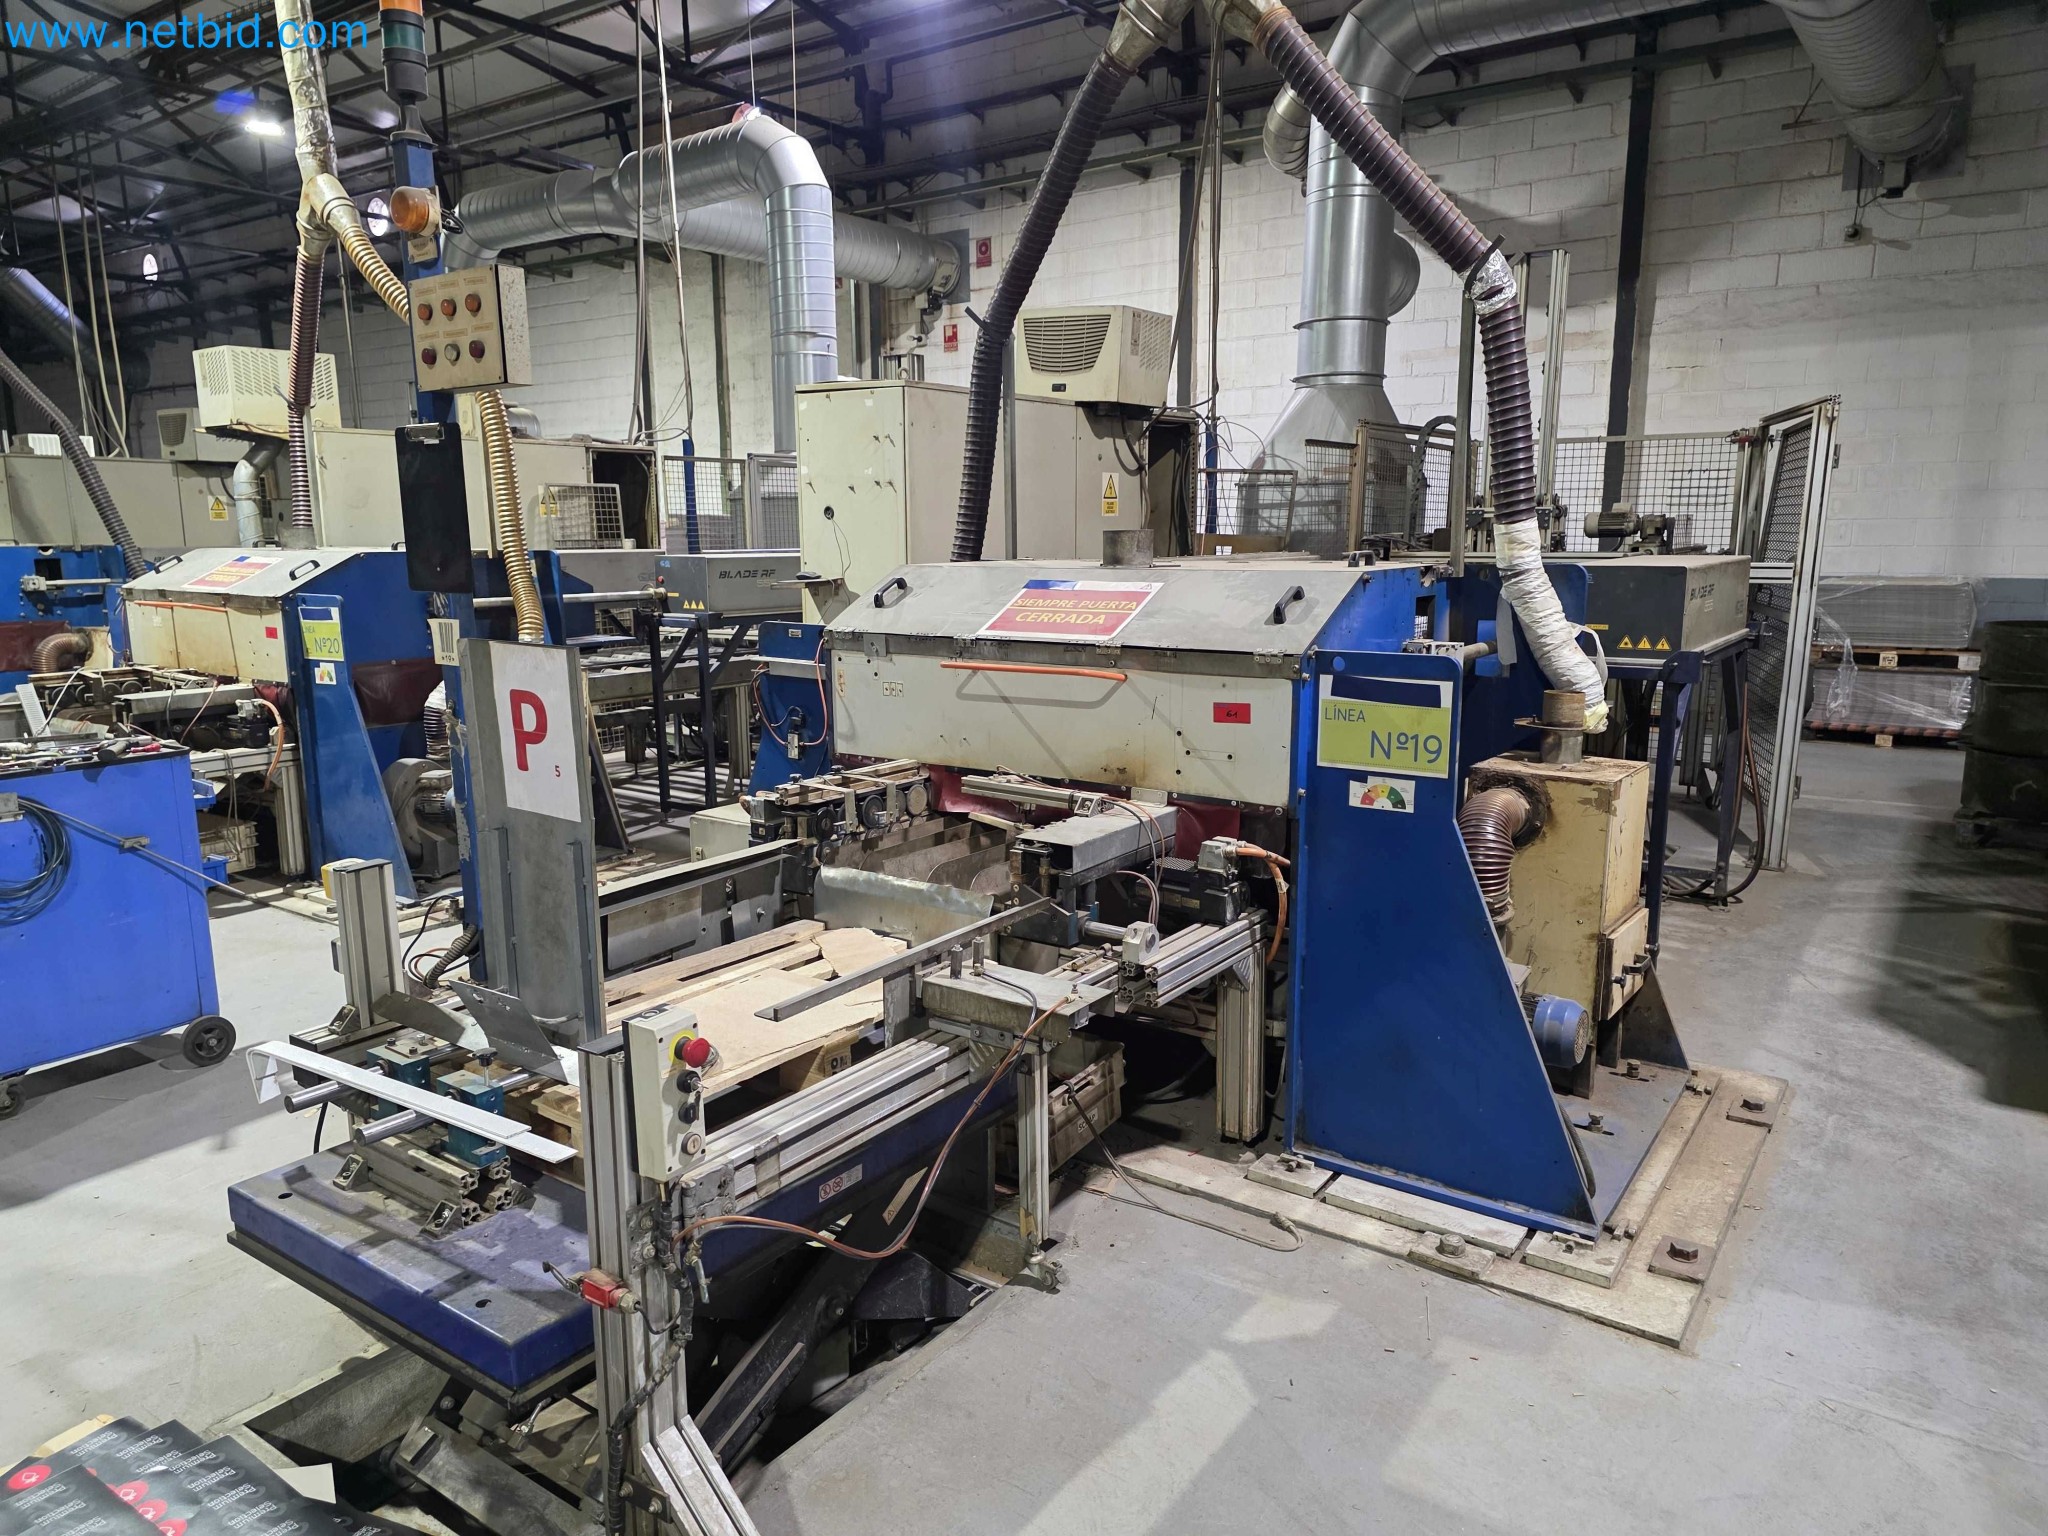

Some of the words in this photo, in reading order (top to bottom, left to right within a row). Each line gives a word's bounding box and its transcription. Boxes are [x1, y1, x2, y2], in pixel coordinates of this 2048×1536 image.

[719, 569, 758, 579] BLADE
[760, 569, 776, 578] RF
[1014, 598, 1078, 608] SIEMPRE
[1079, 600, 1138, 610] PUERTA
[1015, 612, 1106, 624] CERRADA
[1324, 705, 1366, 723] LÍNEA
[510, 688, 548, 771] P
[1370, 730, 1442, 764] Nº19
[555, 765, 561, 777] 5
[75, 1433, 118, 1457] Premium
[121, 1437, 164, 1460] Premium
[173, 1452, 216, 1474] Premium
[192, 1469, 236, 1492] Premium
[212, 1486, 256, 1511] Premium
[232, 1504, 277, 1529] Premium
